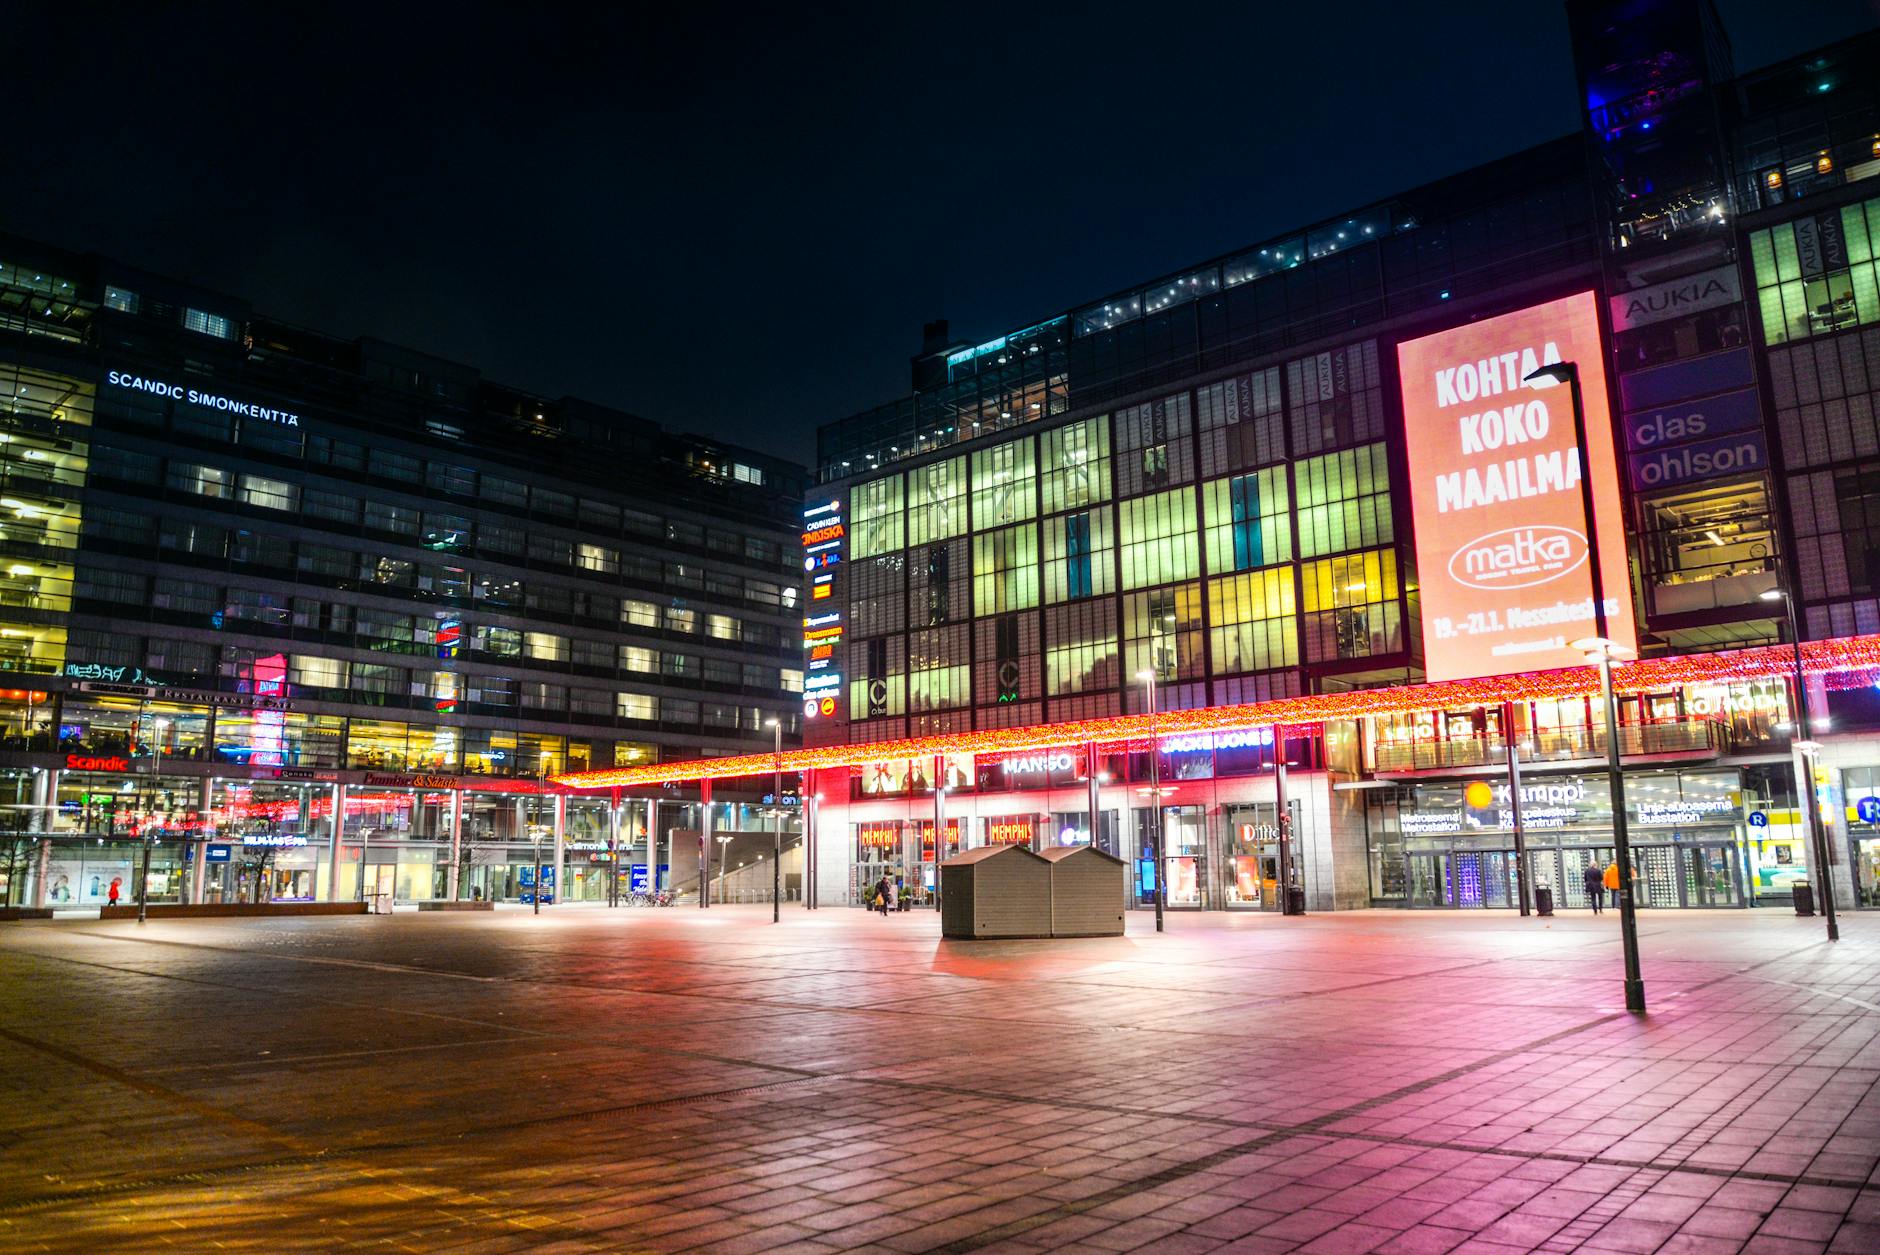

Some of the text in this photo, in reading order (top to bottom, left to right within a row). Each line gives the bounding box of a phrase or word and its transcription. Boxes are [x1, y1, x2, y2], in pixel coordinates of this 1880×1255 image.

[1802, 222, 1818, 271] AUKIA
[1823, 215, 1839, 264] AUKIA
[1624, 279, 1730, 320] AUKIA
[1320, 356, 1331, 397] AUKIA
[108, 370, 299, 428] SCANDIC SIMONKENTTÄ
[1227, 382, 1237, 422] AUKIA
[1459, 399, 1550, 456] KOKO
[1635, 412, 1708, 446] clas
[1436, 447, 1582, 513] MAAILMA
[1641, 444, 1758, 486] ohlson
[1465, 530, 1571, 576] matka
[65, 754, 129, 772] Scandic
[762, 793, 797, 805] sion
[1638, 812, 1701, 824] Busstation
[862, 828, 898, 845] MEMPHIS
[991, 823, 1033, 842] MEMPHIS
